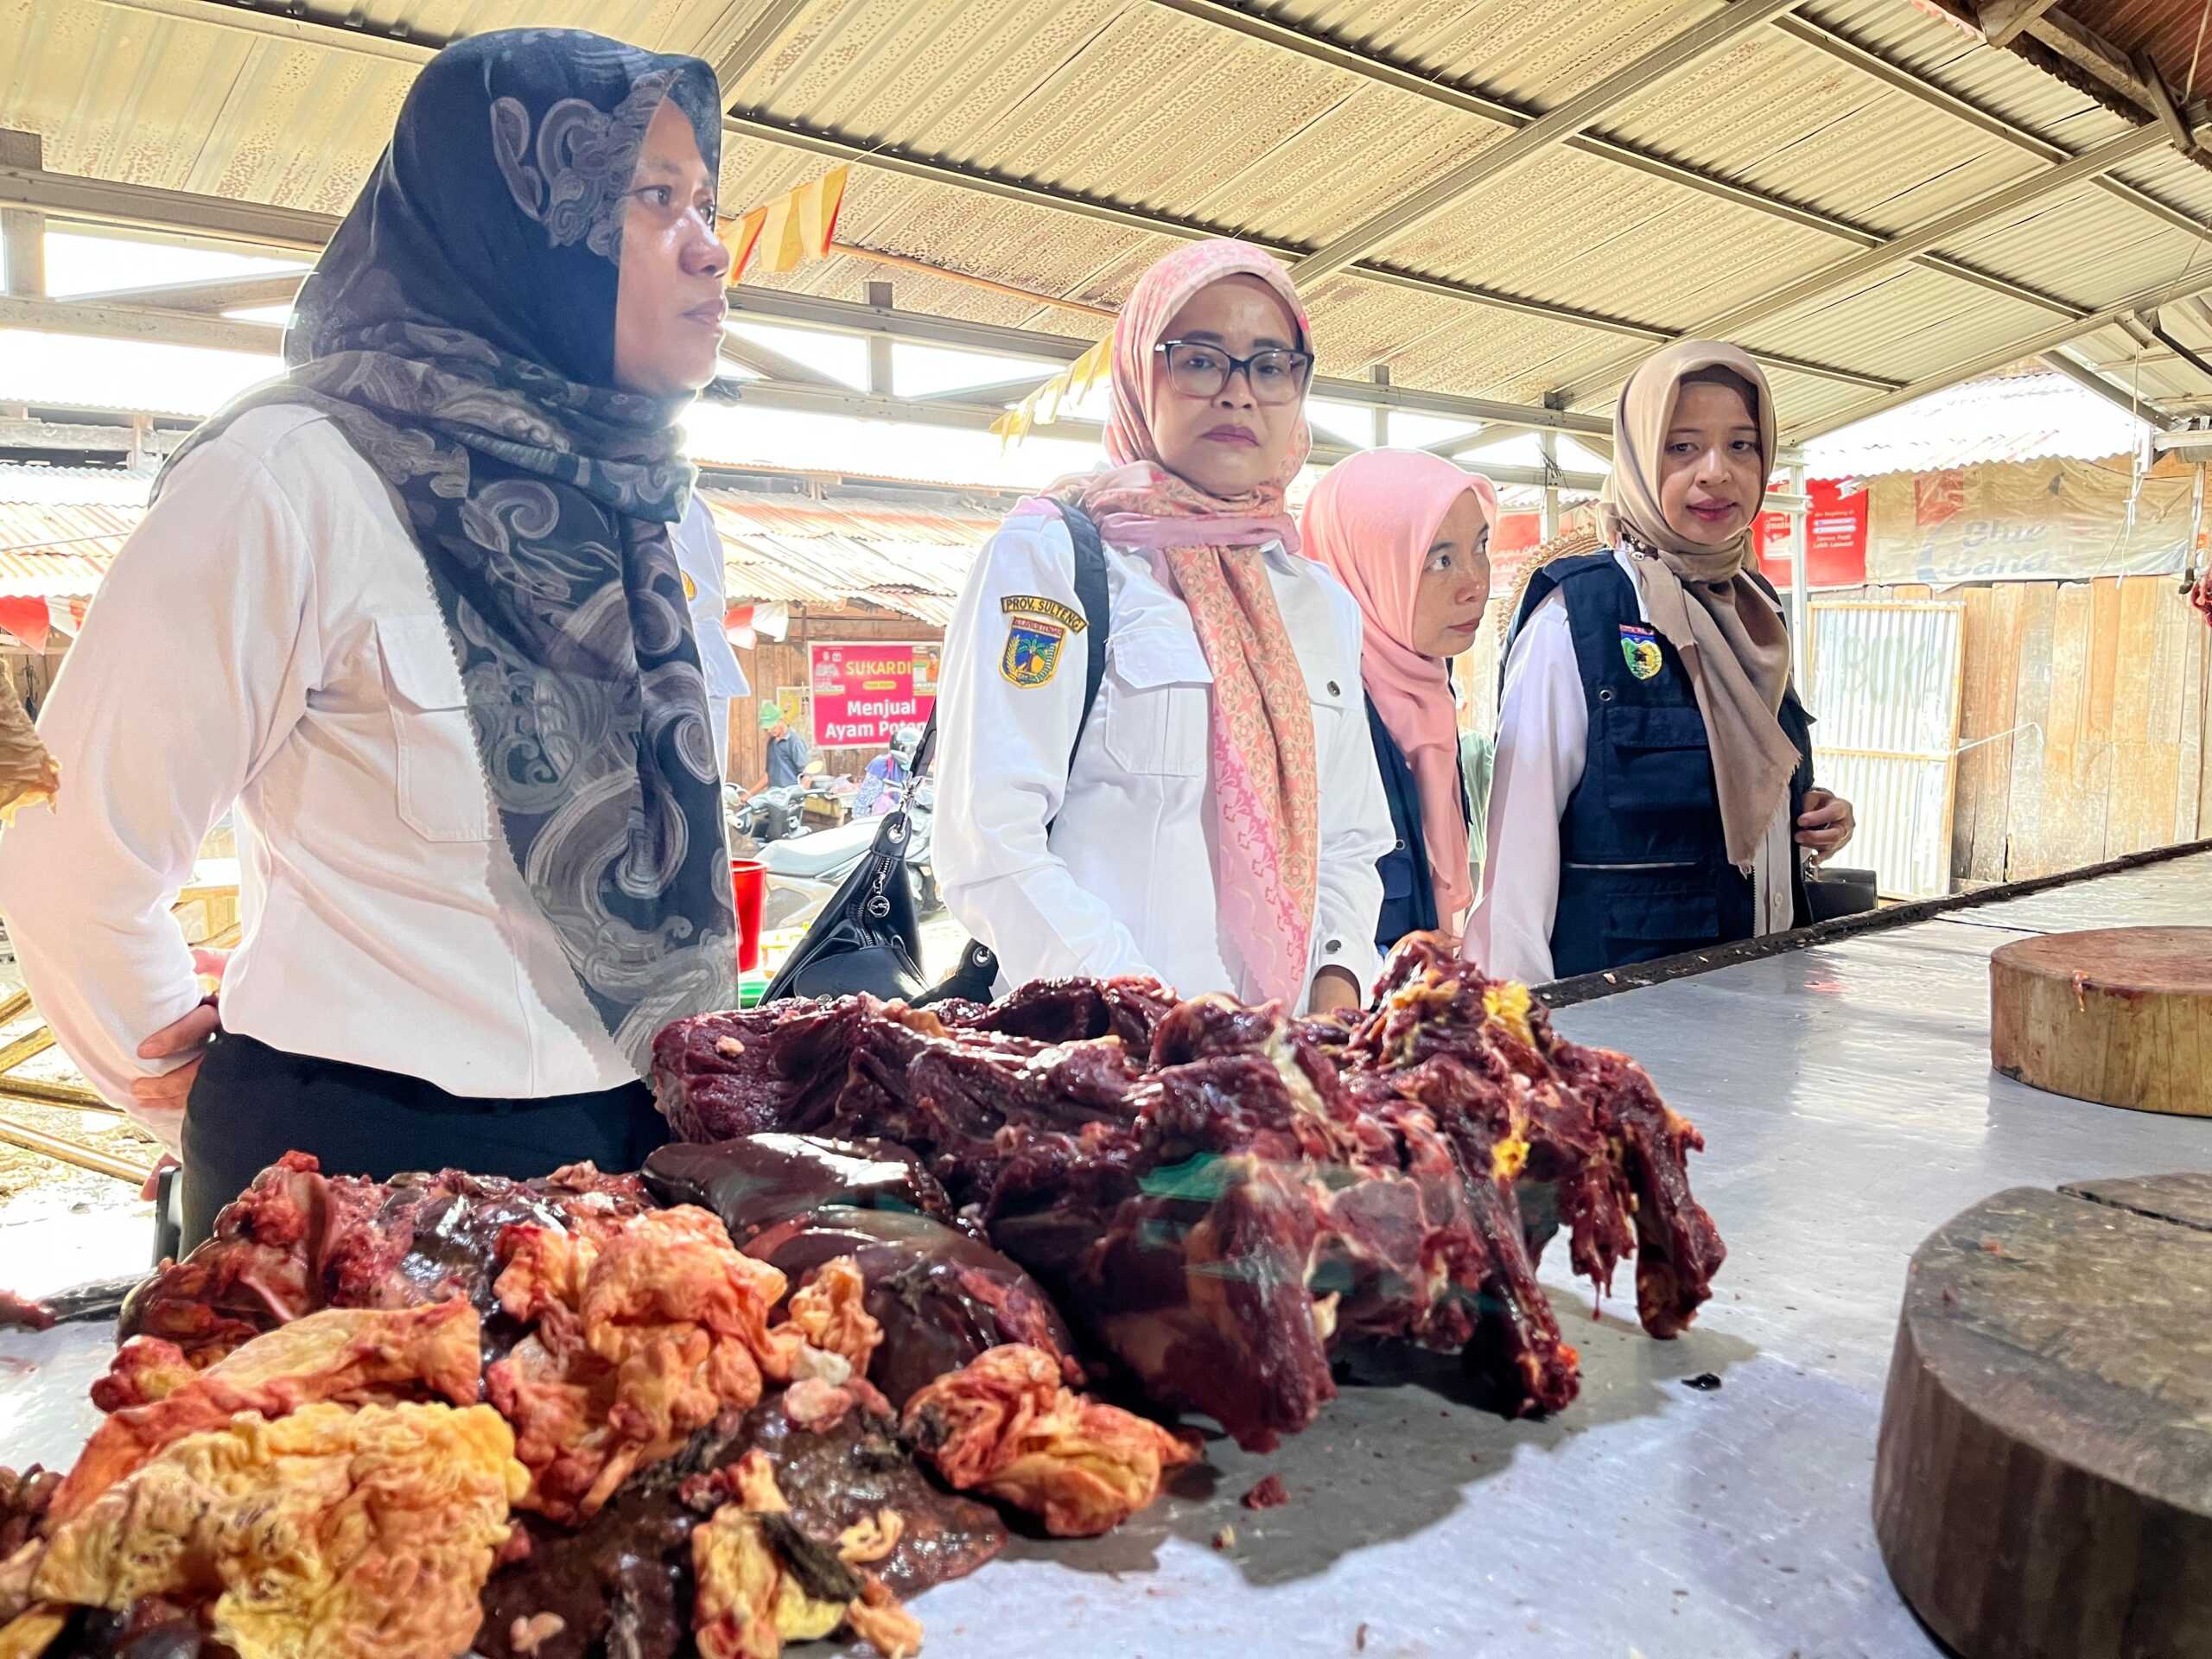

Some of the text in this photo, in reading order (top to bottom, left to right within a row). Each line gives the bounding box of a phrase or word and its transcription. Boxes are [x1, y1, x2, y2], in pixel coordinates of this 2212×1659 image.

[1962, 519, 2046, 547] Blue
[1006, 598, 1035, 611] PROV.
[1039, 601, 1082, 629] SULTENG
[846, 660, 912, 676] SUKARDI
[848, 698, 917, 719] Menjual
[825, 722, 874, 741] Ayam
